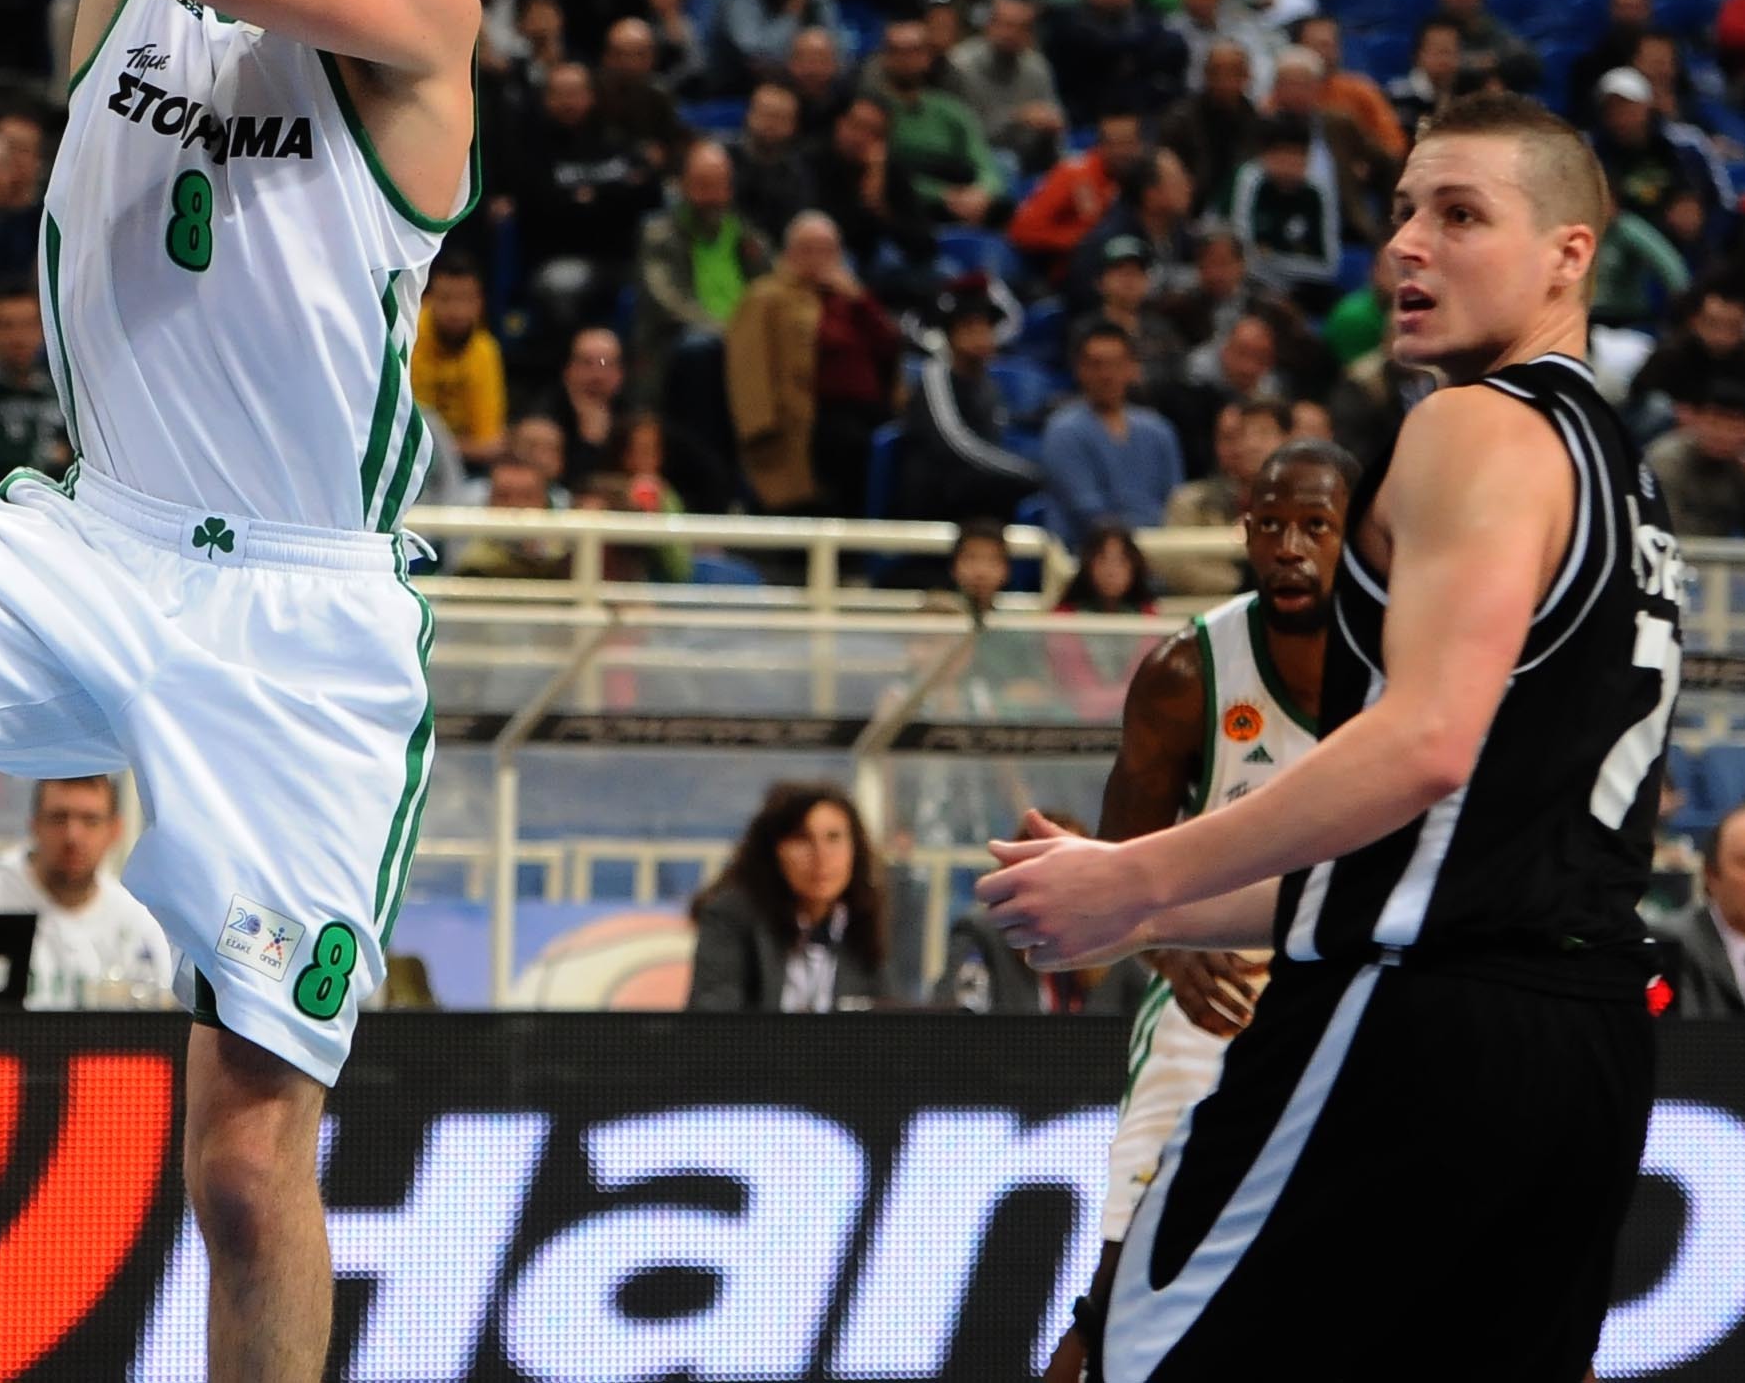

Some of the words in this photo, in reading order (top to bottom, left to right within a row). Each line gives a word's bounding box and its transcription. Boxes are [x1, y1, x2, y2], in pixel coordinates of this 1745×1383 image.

[166, 169, 213, 272] 8
[293, 921, 357, 1021] 8
[126, 1099, 1745, 1383] Han
